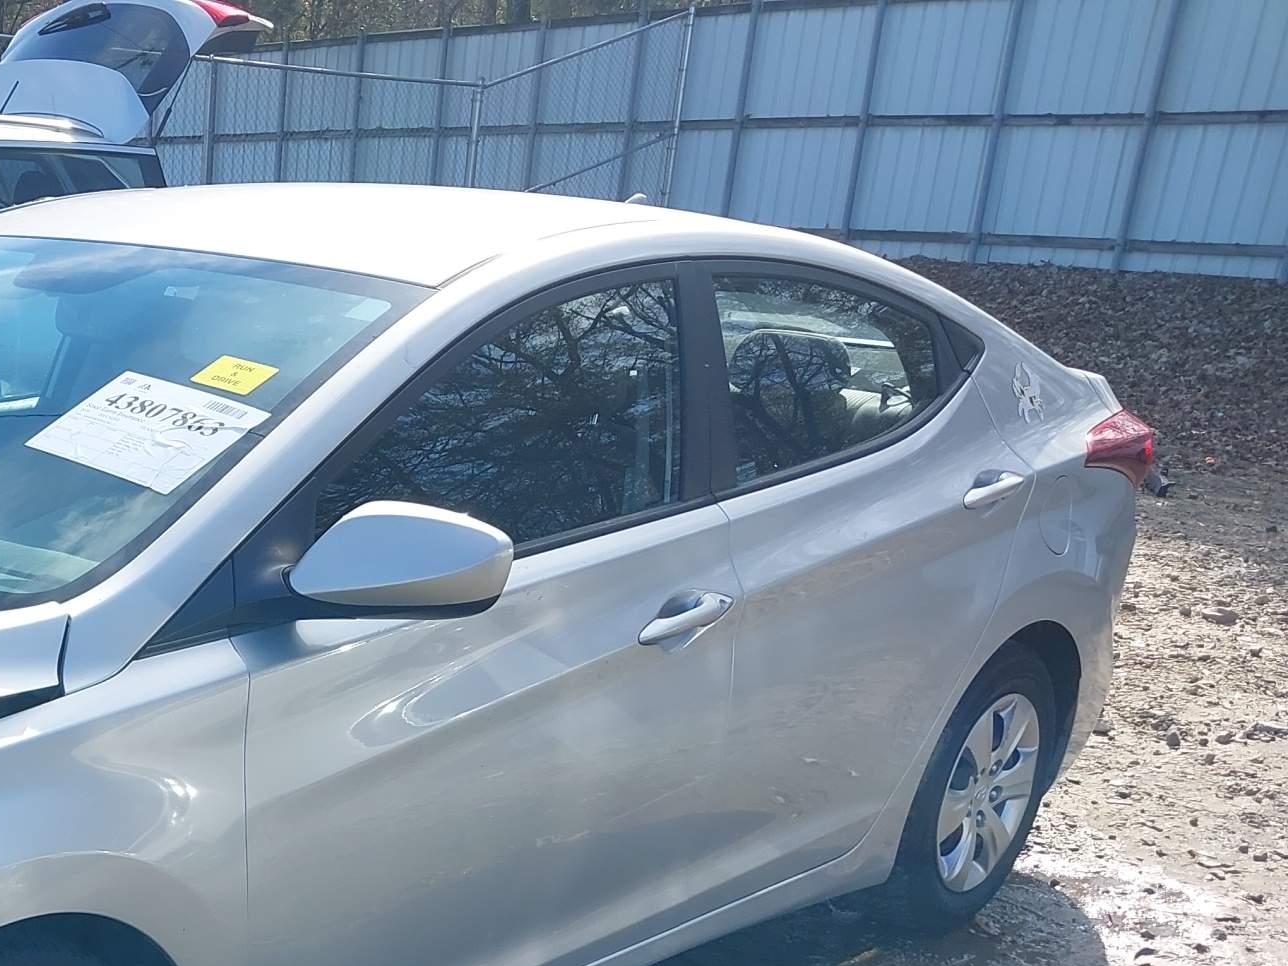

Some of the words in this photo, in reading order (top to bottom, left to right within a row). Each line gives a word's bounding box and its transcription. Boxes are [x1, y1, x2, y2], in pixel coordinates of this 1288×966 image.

[231, 363, 256, 373] RUN
[210, 375, 243, 386] DRIVE
[105, 392, 225, 437] 43807863
